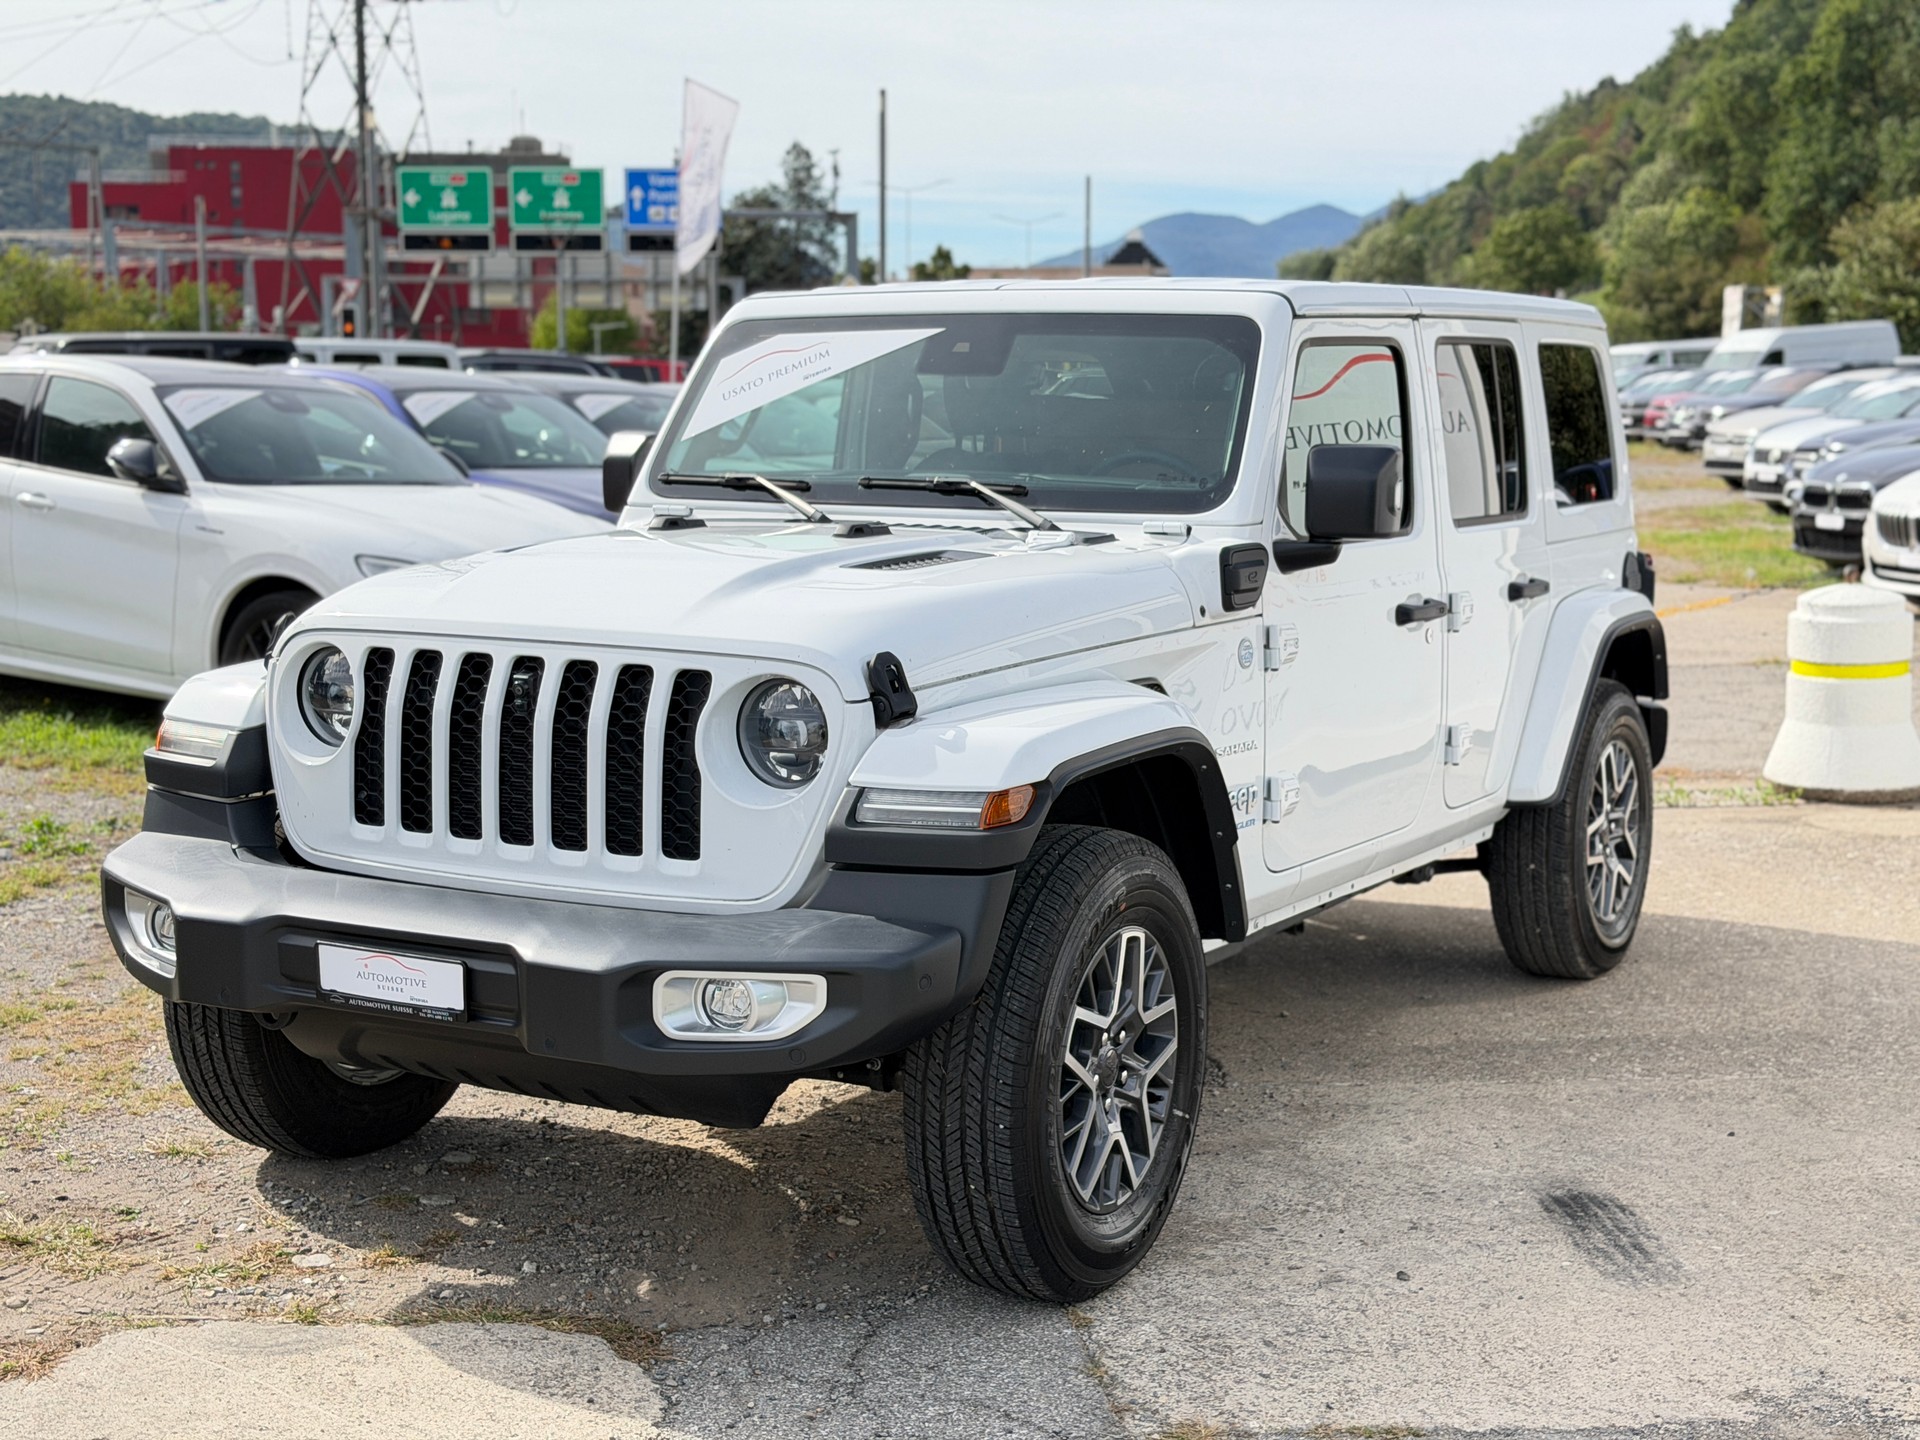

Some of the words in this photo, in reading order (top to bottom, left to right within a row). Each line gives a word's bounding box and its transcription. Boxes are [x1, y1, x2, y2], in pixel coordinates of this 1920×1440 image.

[722, 377, 764, 401] USATO
[768, 349, 831, 382] PREMIUM
[1215, 740, 1258, 756] SAHARA
[1228, 785, 1258, 815] eep
[356, 970, 427, 988] AUTOMOTIVE
[377, 984, 404, 993] SUISSE
[348, 998, 391, 1011] AUTOMOTIVE
[392, 1004, 414, 1014] SUISSE
